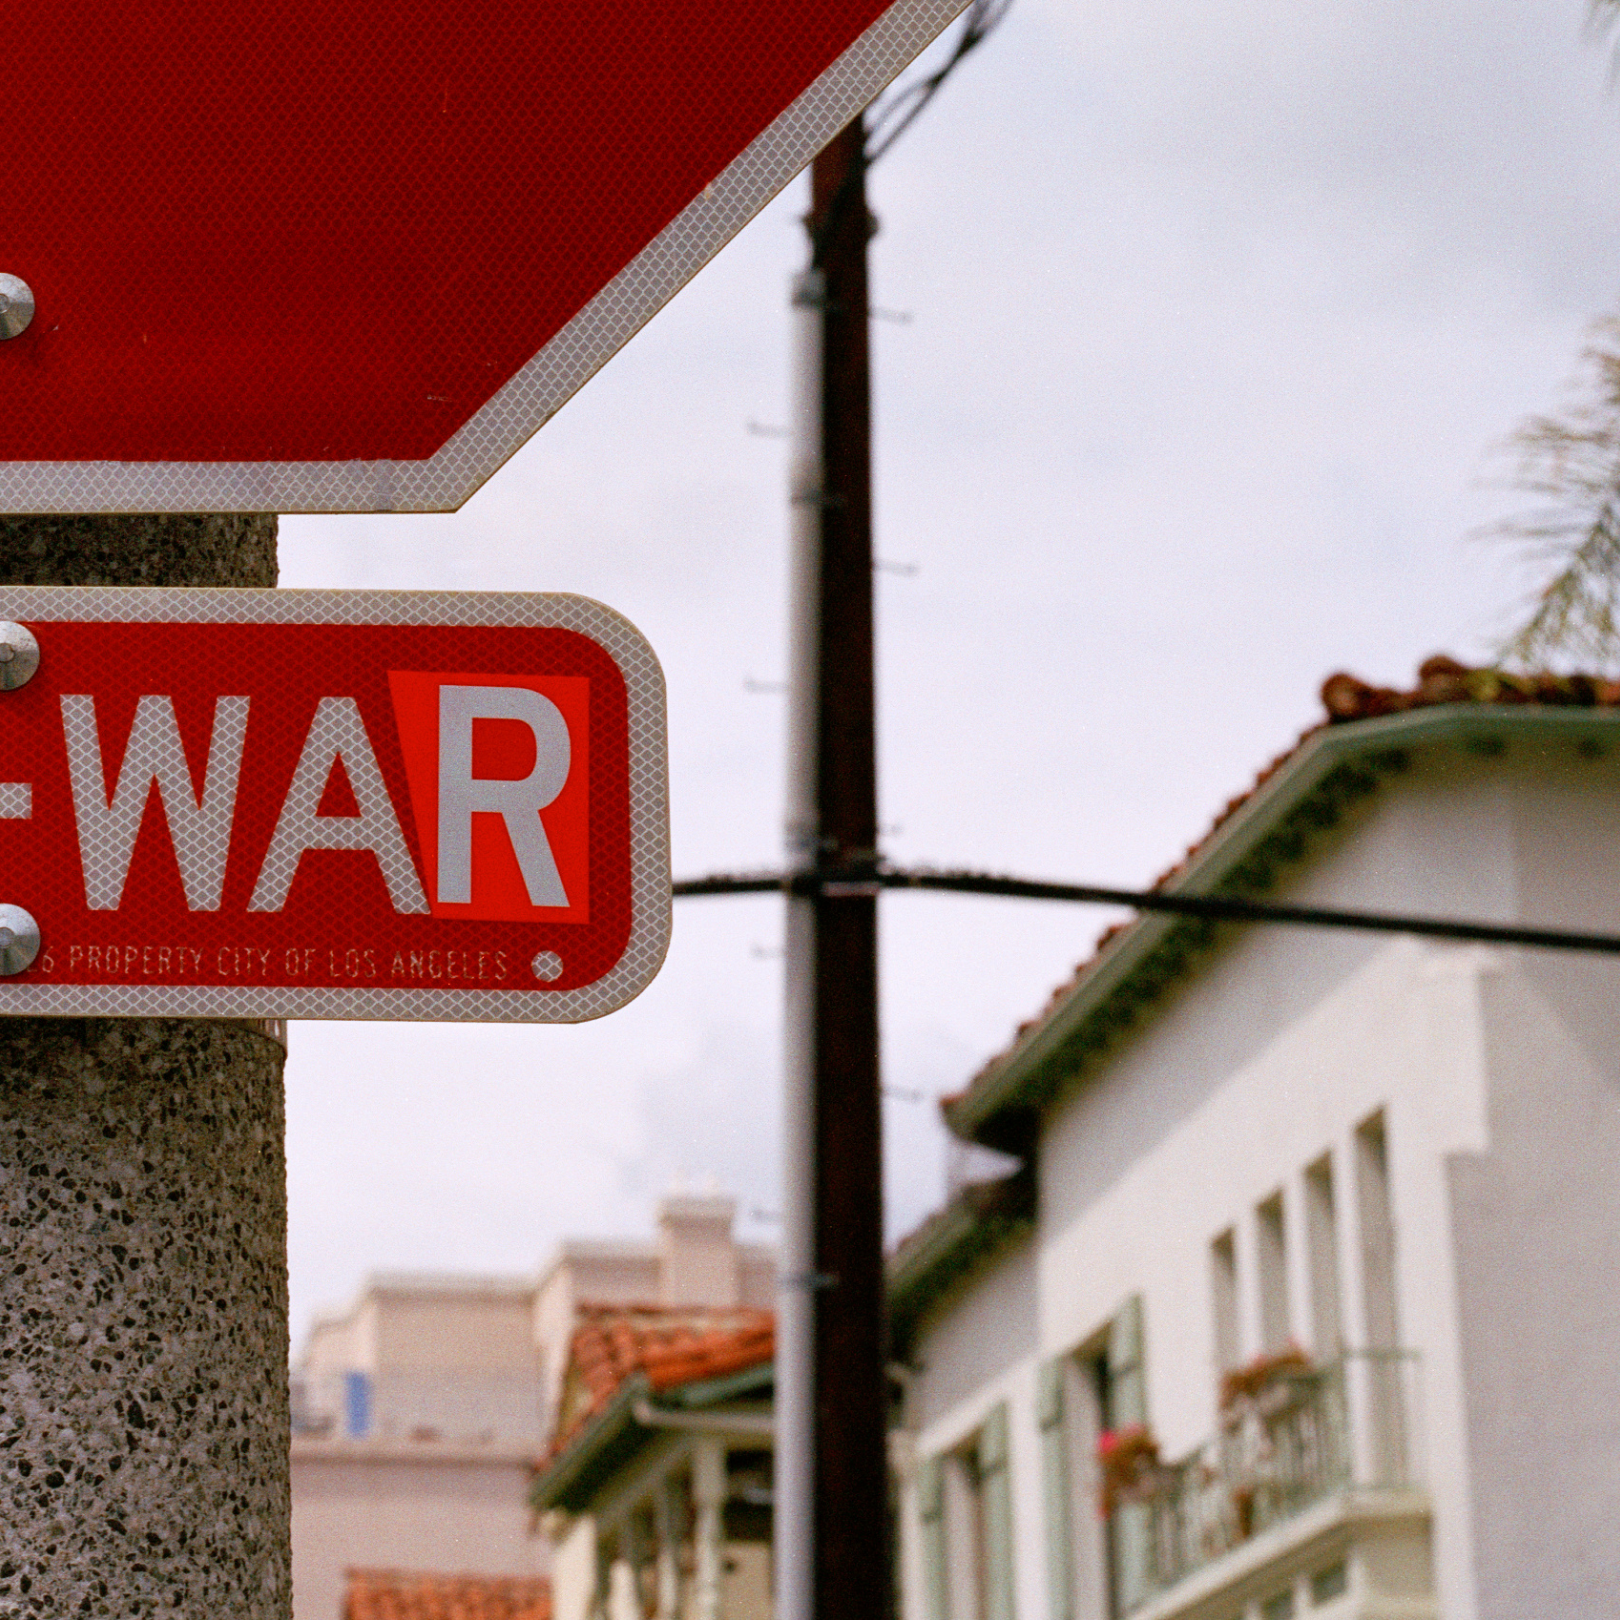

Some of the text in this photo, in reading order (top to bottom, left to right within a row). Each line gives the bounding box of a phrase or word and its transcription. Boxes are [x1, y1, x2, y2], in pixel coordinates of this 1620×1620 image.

[69, 945, 203, 975] PROPERTY
[217, 946, 271, 977] CITY
[284, 948, 316, 977] OF
[329, 949, 377, 979] LOS
[391, 950, 508, 981] ANGELES
